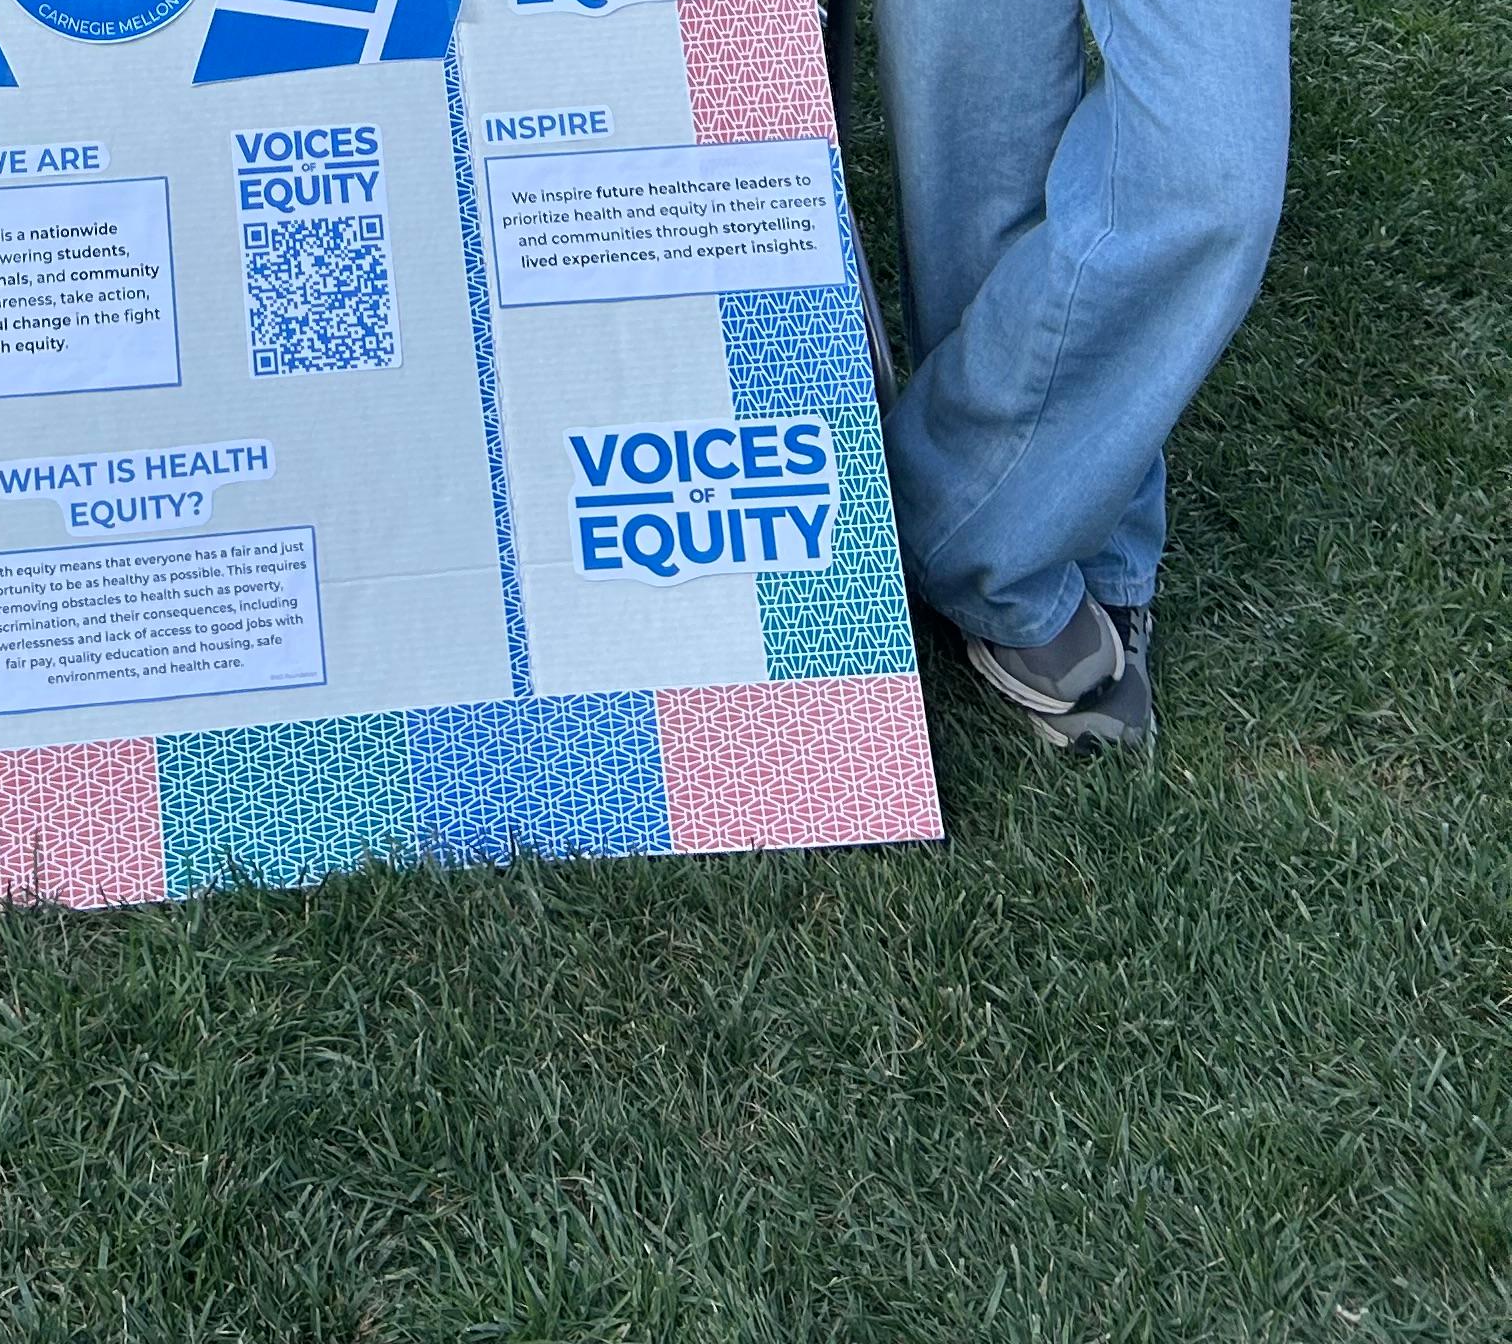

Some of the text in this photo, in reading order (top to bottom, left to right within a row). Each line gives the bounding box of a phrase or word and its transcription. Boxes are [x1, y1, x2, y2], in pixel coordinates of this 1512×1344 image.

[38, 3, 115, 35] CARNEGIE
[485, 110, 609, 142] INSPIRE
[36, 145, 100, 173] ARE
[236, 127, 378, 163] VOICES
[301, 162, 316, 172] OF
[240, 171, 379, 213] EQUITY
[511, 175, 812, 205] We inspire future healthcare leaders to
[502, 196, 827, 230] prioritize health and equity in their careers
[0, 228, 13, 242] is
[16, 230, 25, 241] a
[30, 221, 118, 241] nationwide
[518, 216, 815, 247] and communities through storytelling,
[56, 244, 130, 261] students,
[521, 238, 817, 269] lived experiences, and expert insights.
[36, 269, 66, 284] and
[70, 263, 160, 282] community
[59, 289, 94, 305] take
[98, 286, 150, 302] action,
[12, 315, 72, 331] change
[75, 311, 90, 326] in
[94, 310, 120, 325] the
[123, 307, 161, 325] fight
[15, 335, 69, 355] equity.
[107, 458, 136, 485] IS
[145, 445, 269, 481] HEALTH
[569, 424, 827, 487] VOICES
[70, 491, 204, 529] EQUITY?
[689, 488, 714, 504] OF
[579, 504, 832, 578] EQUITY
[16, 562, 57, 578] equity
[59, 560, 103, 573] means
[104, 556, 132, 569] that
[134, 552, 193, 567] everyone
[194, 549, 218, 561] has
[220, 549, 228, 559] a
[230, 544, 252, 558] fair
[253, 542, 278, 556] and
[279, 541, 305, 556] just
